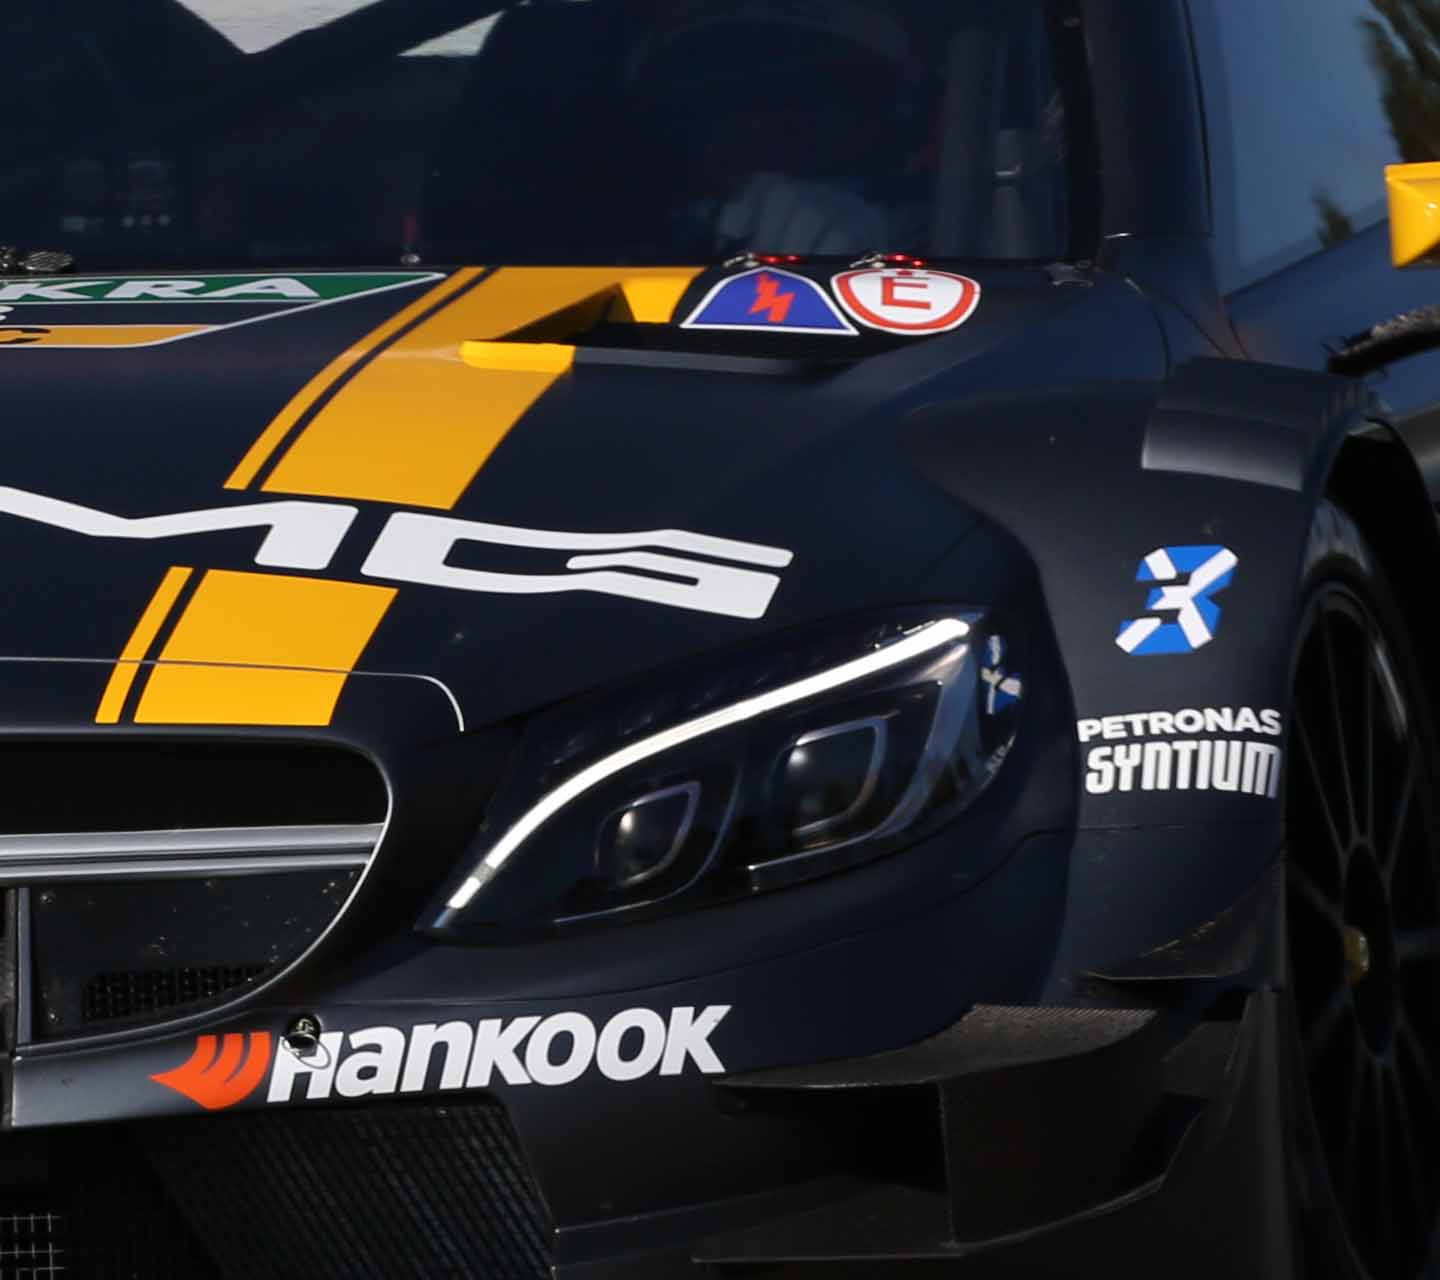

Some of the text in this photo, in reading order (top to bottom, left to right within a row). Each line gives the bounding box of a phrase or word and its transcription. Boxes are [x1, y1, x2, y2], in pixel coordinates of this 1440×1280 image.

[881, 276, 932, 310] E
[1115, 544, 1239, 655] 3
[1076, 706, 1283, 743] PETRONAS
